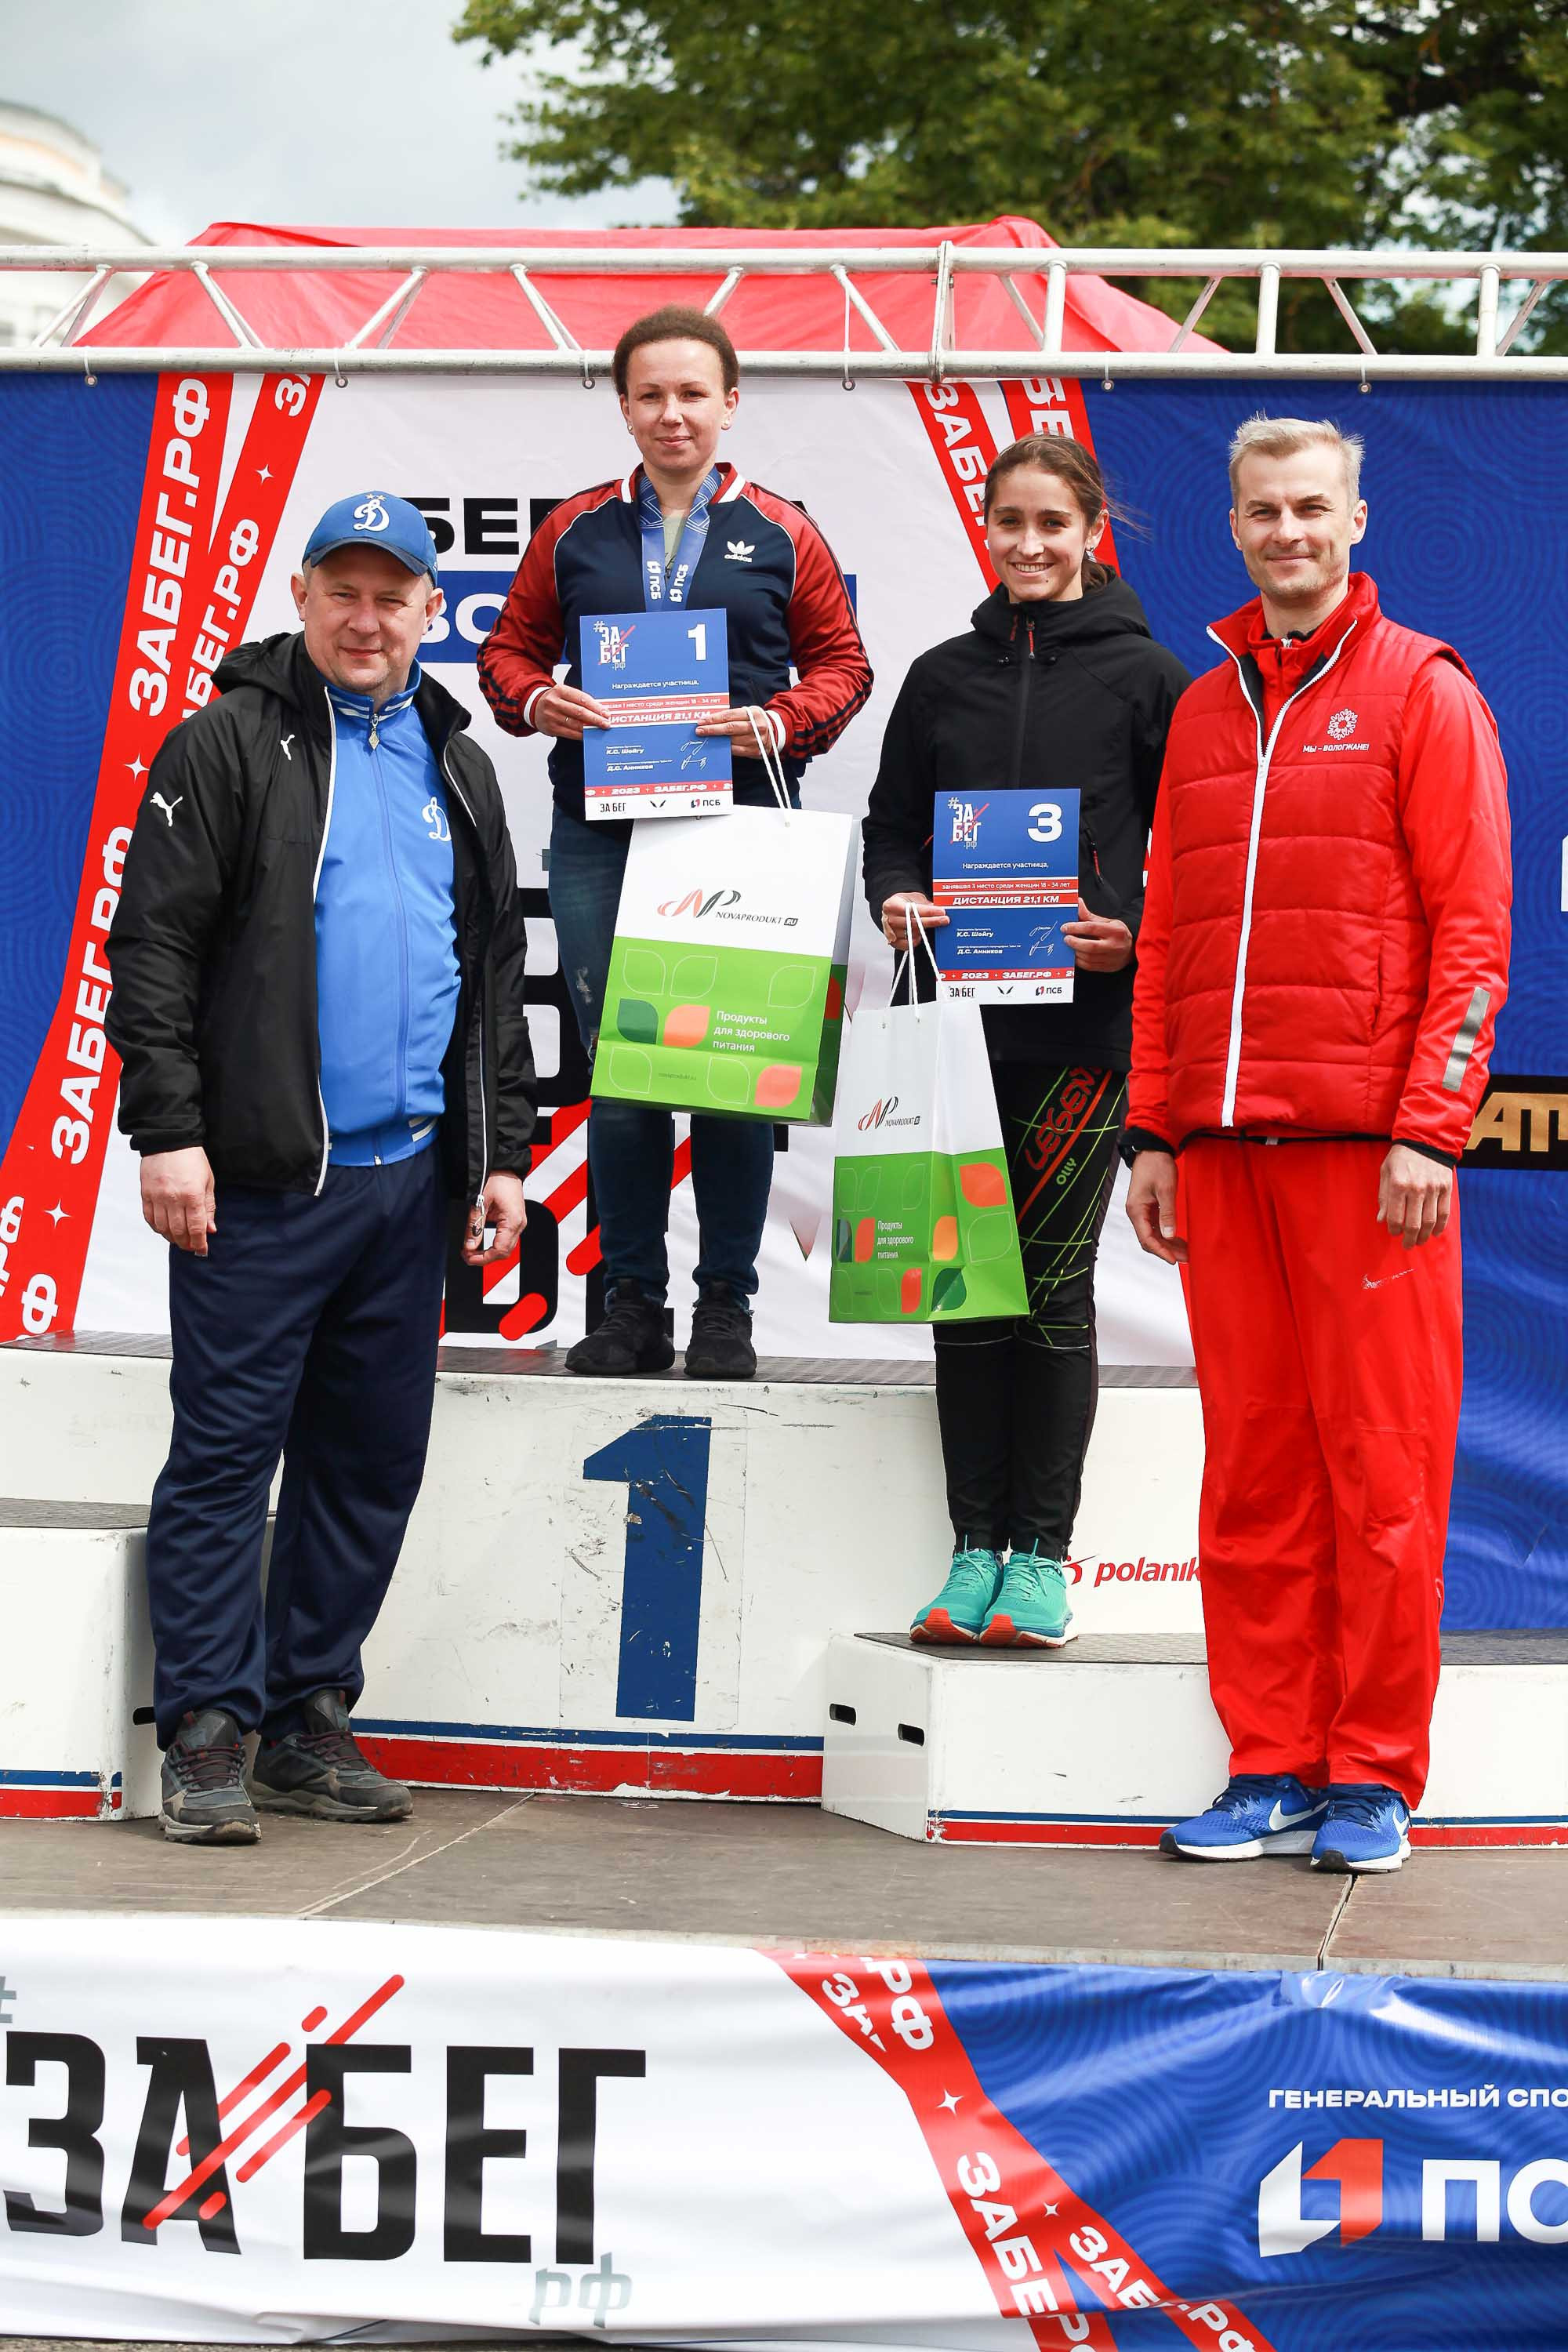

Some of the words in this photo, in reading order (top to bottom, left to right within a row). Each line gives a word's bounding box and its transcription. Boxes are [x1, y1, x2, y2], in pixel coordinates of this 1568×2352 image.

[129, 378, 210, 717] ЗАБЕГ.РФ
[181, 519, 260, 722] БЕГ.РФ
[688, 623, 707, 661] 1
[612, 681, 662, 690] Награждается
[607, 712, 672, 723] ИСТАНЦИЯ
[654, 784, 707, 793] ЗАБЕГ.РФ
[1027, 803, 1063, 843] 3
[953, 896, 1022, 906] ДИСТАНЦИЯ
[1022, 896, 1041, 905] 21,1
[716, 1010, 768, 1026] Продукты
[712, 1040, 755, 1053] питания
[713, 1026, 733, 1036] для
[735, 1028, 790, 1042] здорового
[1025, 1066, 1102, 1170] LEGEN
[583, 1414, 712, 1722] 1
[1094, 1556, 1201, 1588] polanik
[1269, 2083, 1500, 2109] ГЕНЕРАЛЬНЫЙ
